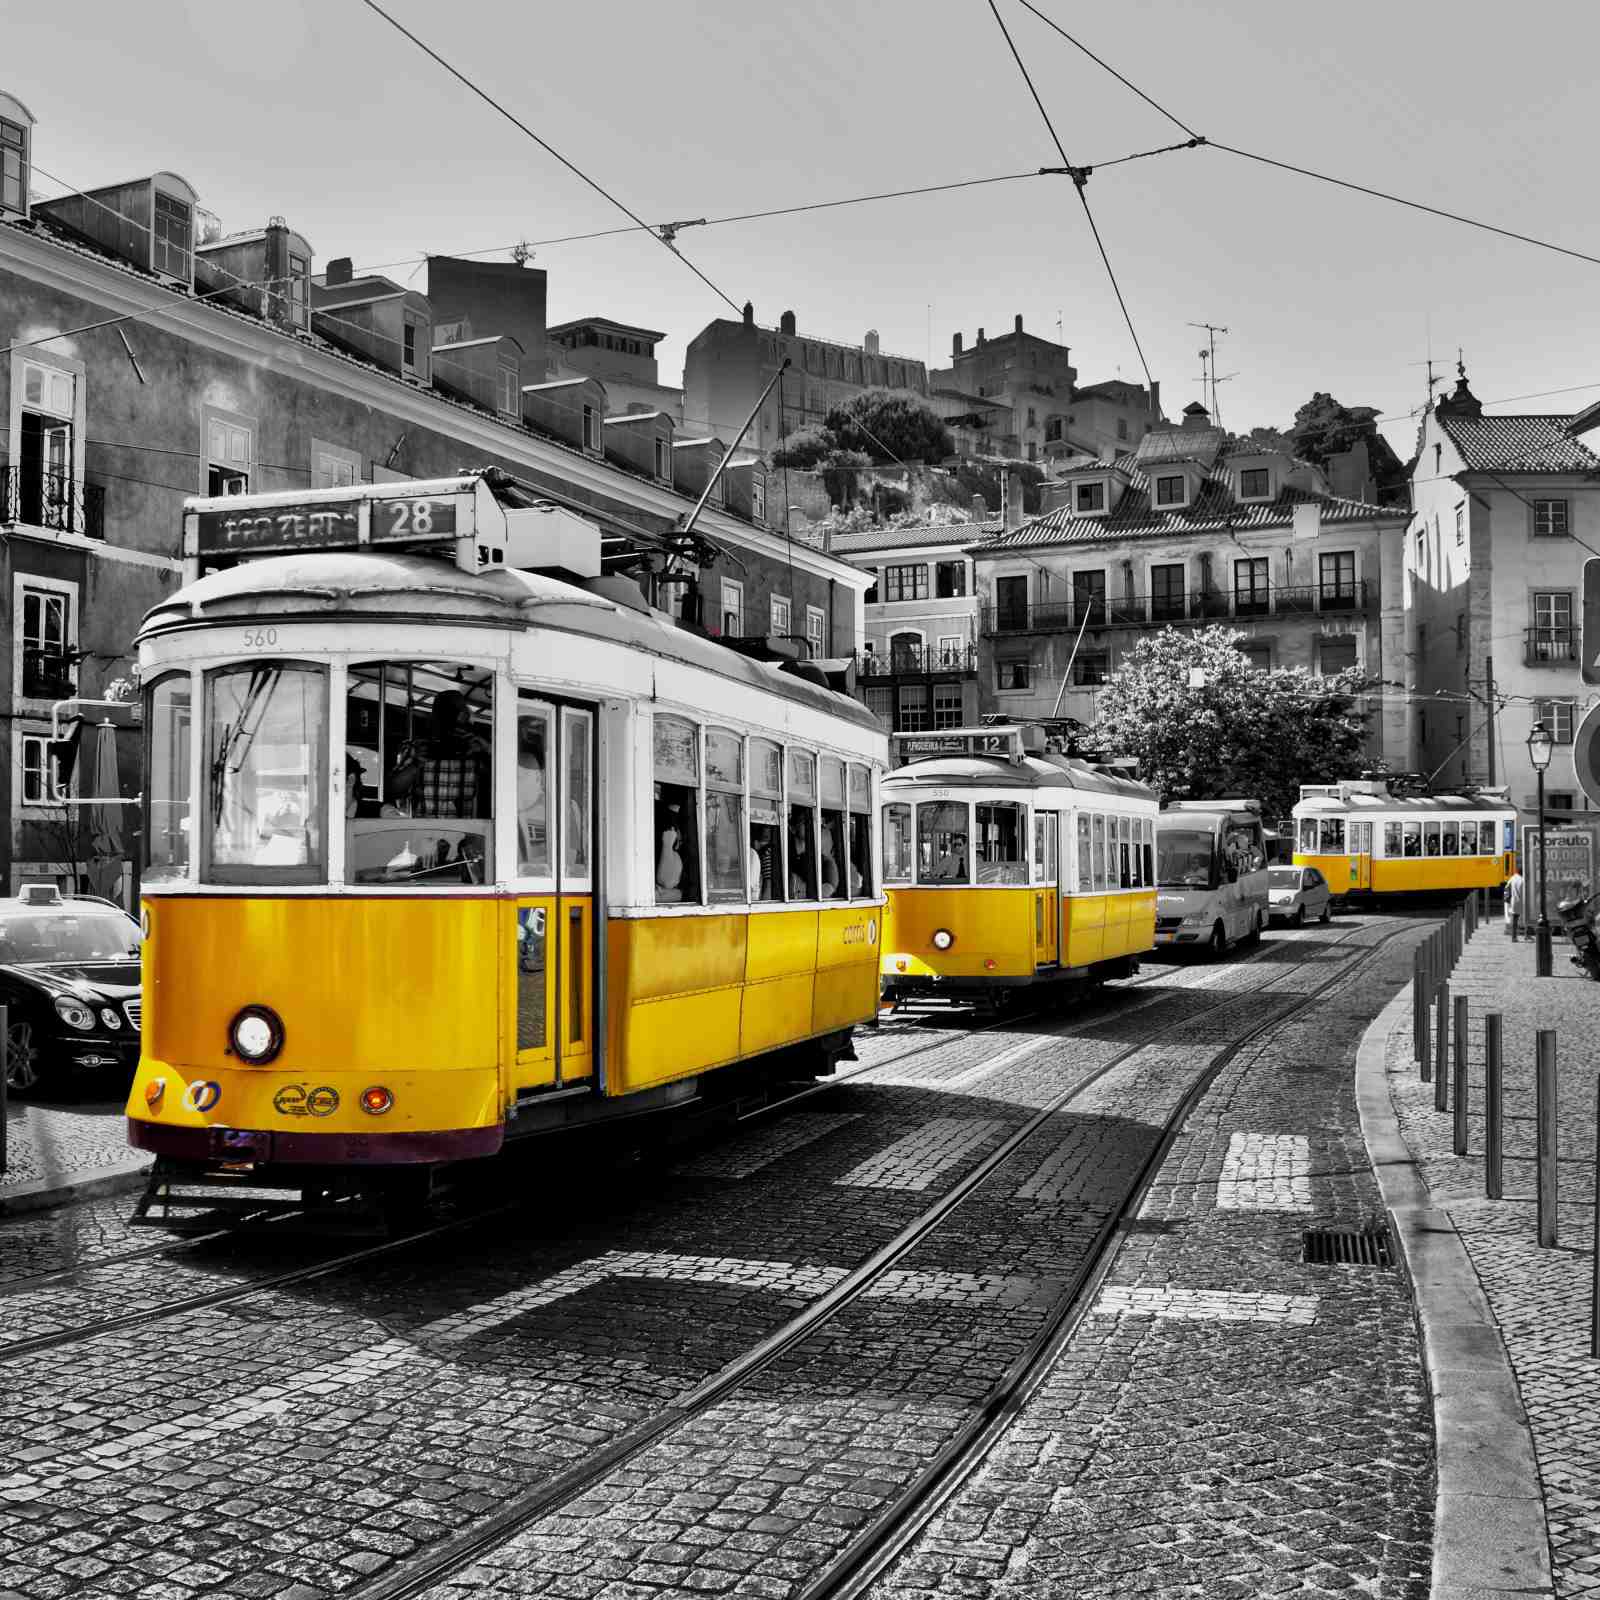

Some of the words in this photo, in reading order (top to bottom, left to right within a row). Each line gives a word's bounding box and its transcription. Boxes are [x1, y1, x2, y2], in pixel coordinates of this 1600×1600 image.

[389, 501, 433, 535] 28
[243, 627, 278, 648] 560
[982, 736, 1000, 751] 12
